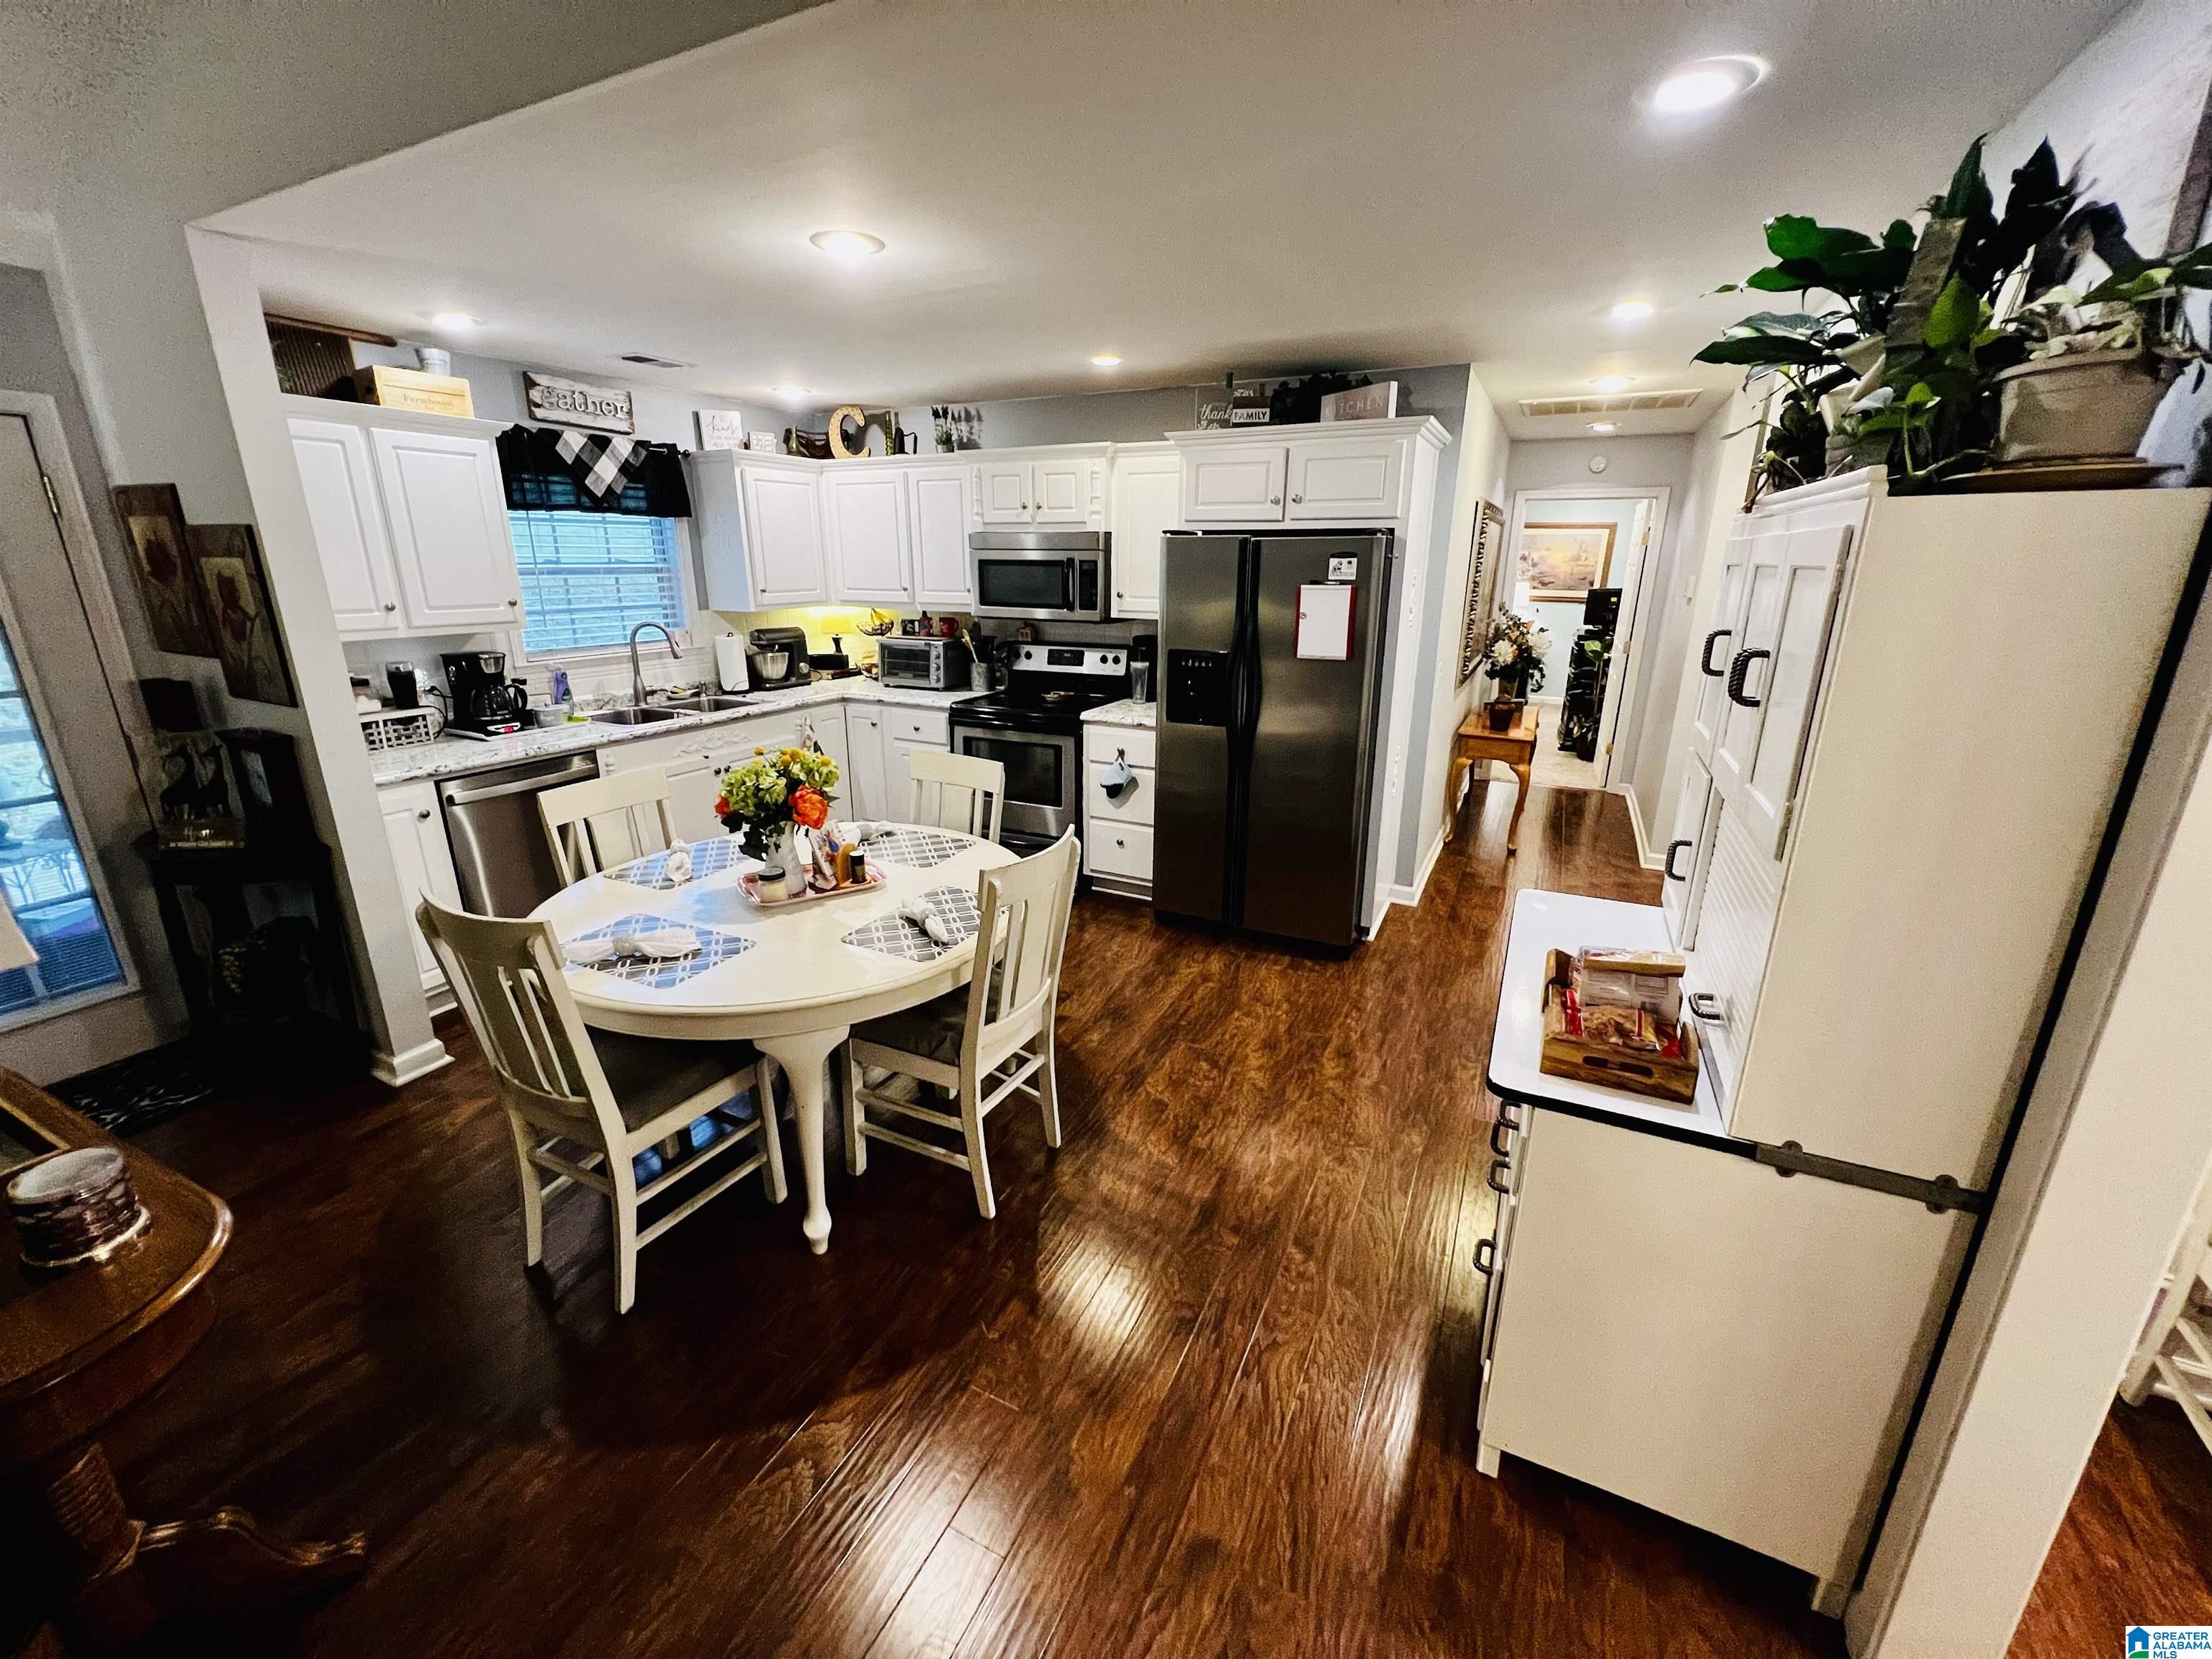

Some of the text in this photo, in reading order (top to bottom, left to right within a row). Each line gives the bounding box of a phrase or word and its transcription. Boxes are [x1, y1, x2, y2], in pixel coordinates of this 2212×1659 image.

[541, 387, 629, 418] gather
[1324, 396, 1384, 418] KITCHEN
[1233, 410, 1268, 422] FAMILY
[828, 406, 871, 458] C
